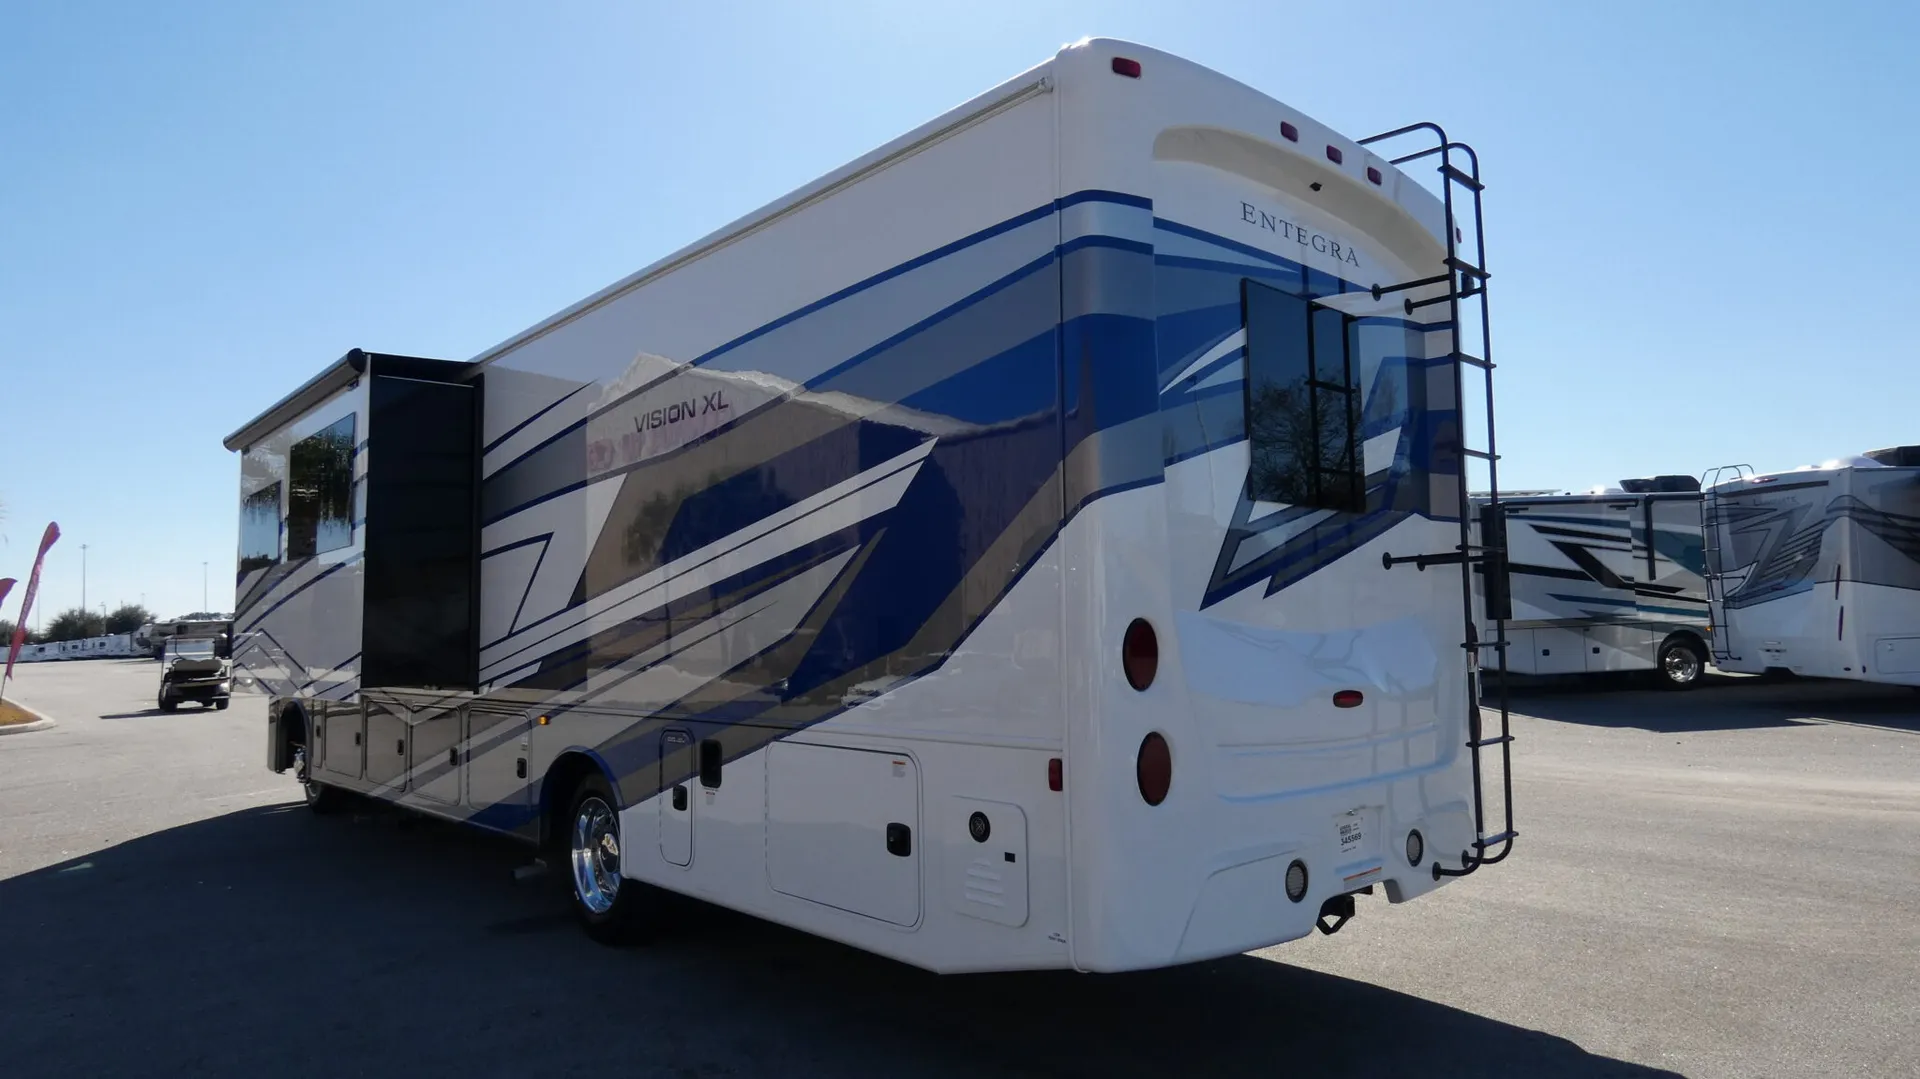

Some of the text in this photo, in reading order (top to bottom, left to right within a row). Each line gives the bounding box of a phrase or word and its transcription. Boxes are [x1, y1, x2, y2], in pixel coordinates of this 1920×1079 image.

[1240, 201, 1360, 268] ENTEGRA
[634, 390, 729, 433] VISION XL
